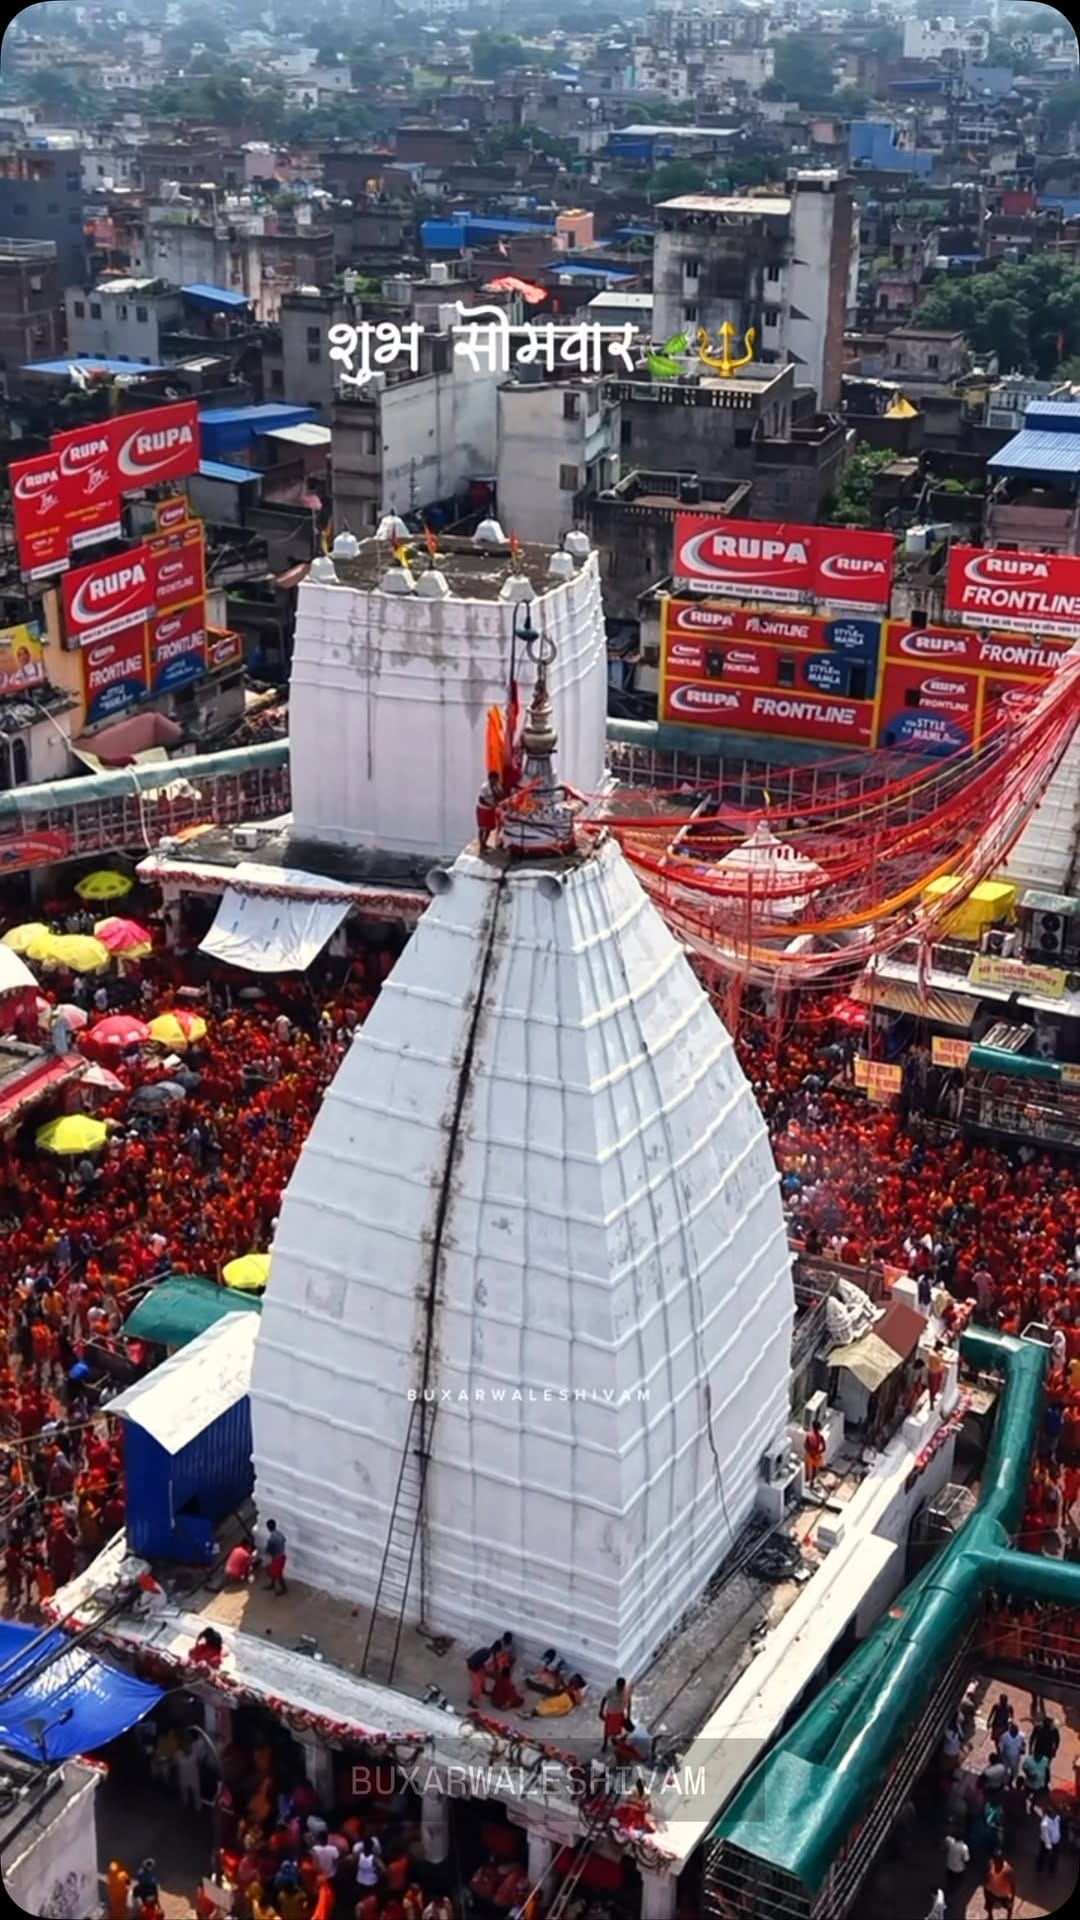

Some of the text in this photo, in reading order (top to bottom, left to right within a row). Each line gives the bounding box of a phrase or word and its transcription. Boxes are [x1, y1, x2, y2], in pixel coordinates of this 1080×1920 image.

[70, 439, 109, 462] RUPA
[136, 425, 193, 456] RUPA
[25, 469, 59, 488] RUPA
[713, 535, 808, 564] RUPA
[837, 557, 886, 573] RUPA
[986, 558, 1049, 578] RUPA
[89, 564, 147, 601] RUPA
[690, 610, 733, 627] RUPA
[157, 630, 205, 662] FRONTLINE
[915, 636, 966, 653] RUPA
[88, 655, 143, 689] FRONTLINE
[930, 680, 966, 694] RUPA
[686, 689, 857, 726] RUPA FRONTLINE
[919, 698, 970, 713] FRONTLINE
[917, 718, 946, 731] STYLE
